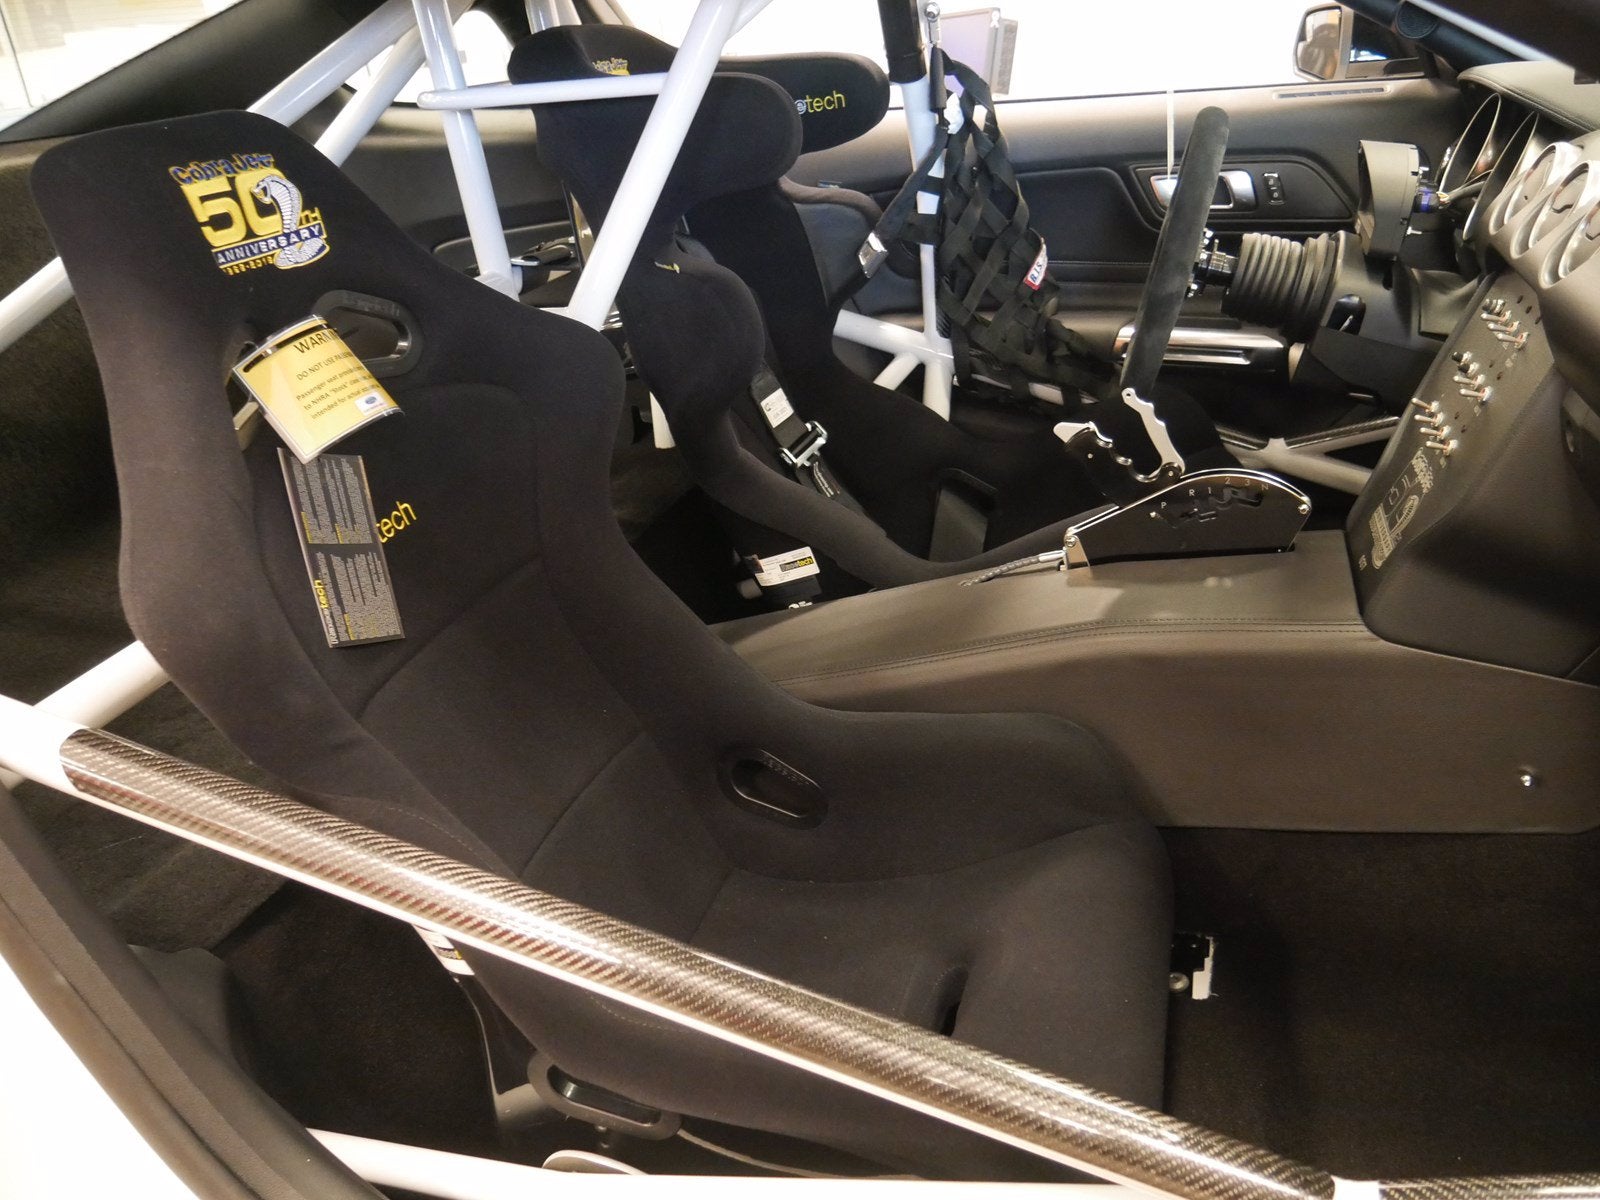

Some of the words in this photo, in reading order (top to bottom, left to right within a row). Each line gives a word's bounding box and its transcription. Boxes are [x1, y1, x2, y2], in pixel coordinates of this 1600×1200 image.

[168, 159, 238, 185] Cobra
[234, 153, 275, 171] Jet
[180, 168, 287, 248] 50
[217, 225, 323, 264] ANNIVERSARY
[296, 370, 309, 381] DO
[308, 361, 323, 374] NOT
[296, 382, 326, 401] Passenger
[1161, 501, 1167, 509] P
[1188, 488, 1195, 497] R
[1225, 476, 1231, 485] 2
[1244, 478, 1250, 486] 3
[1261, 483, 1269, 491] N
